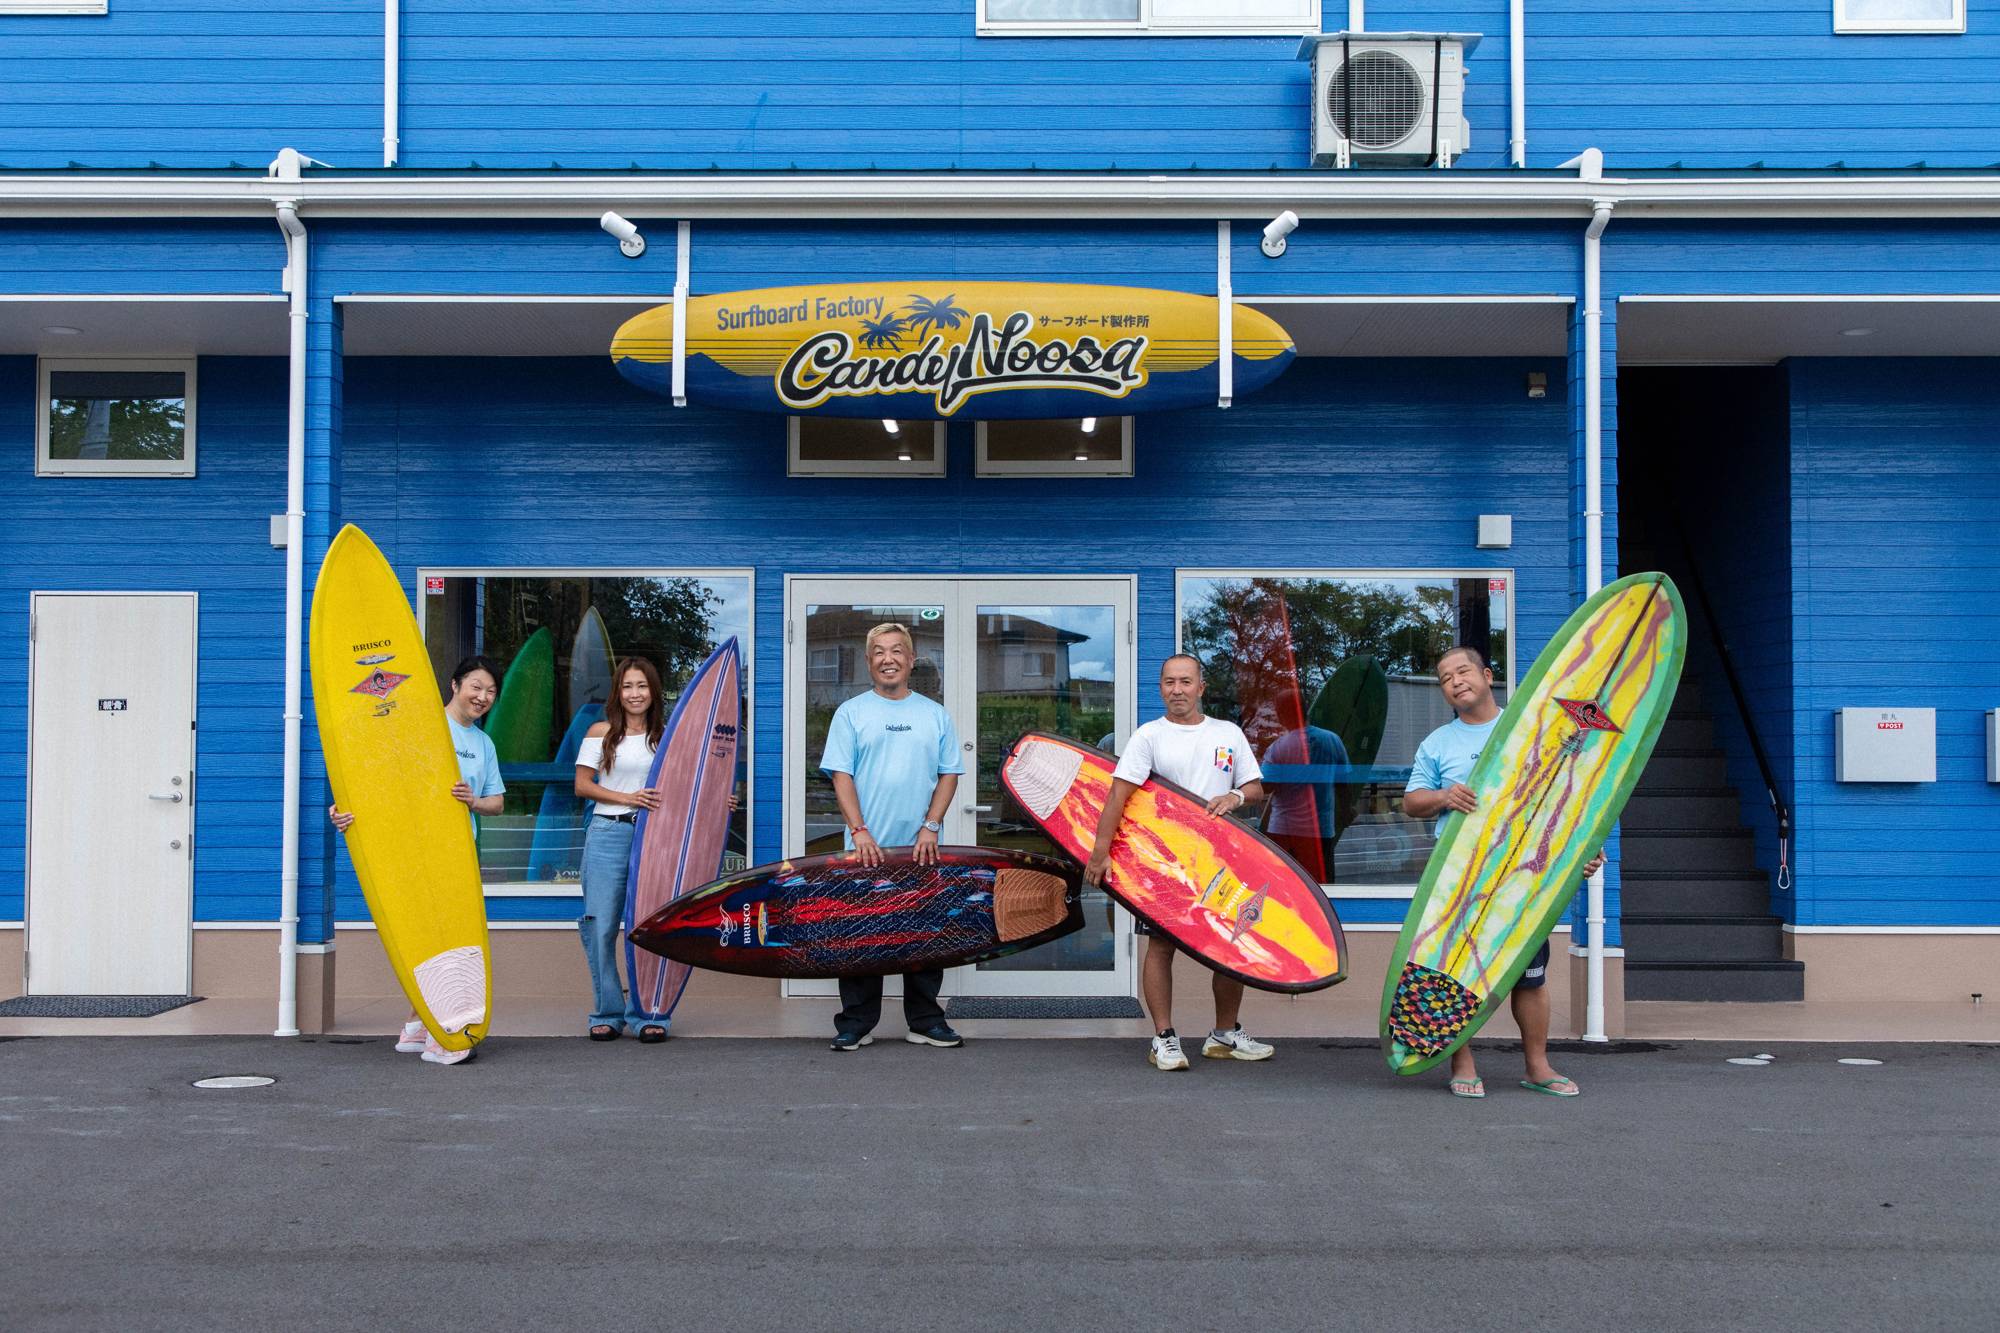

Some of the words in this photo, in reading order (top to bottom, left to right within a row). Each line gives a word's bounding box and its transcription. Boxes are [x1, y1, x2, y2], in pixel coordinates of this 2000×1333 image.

[717, 299, 808, 331] Surfboard
[815, 296, 884, 321] Factory
[1038, 314, 1150, 328] サーフボード製作所
[352, 639, 392, 652] BRUSCO
[723, 857, 746, 872] UB
[743, 903, 751, 945] BRUSCO
